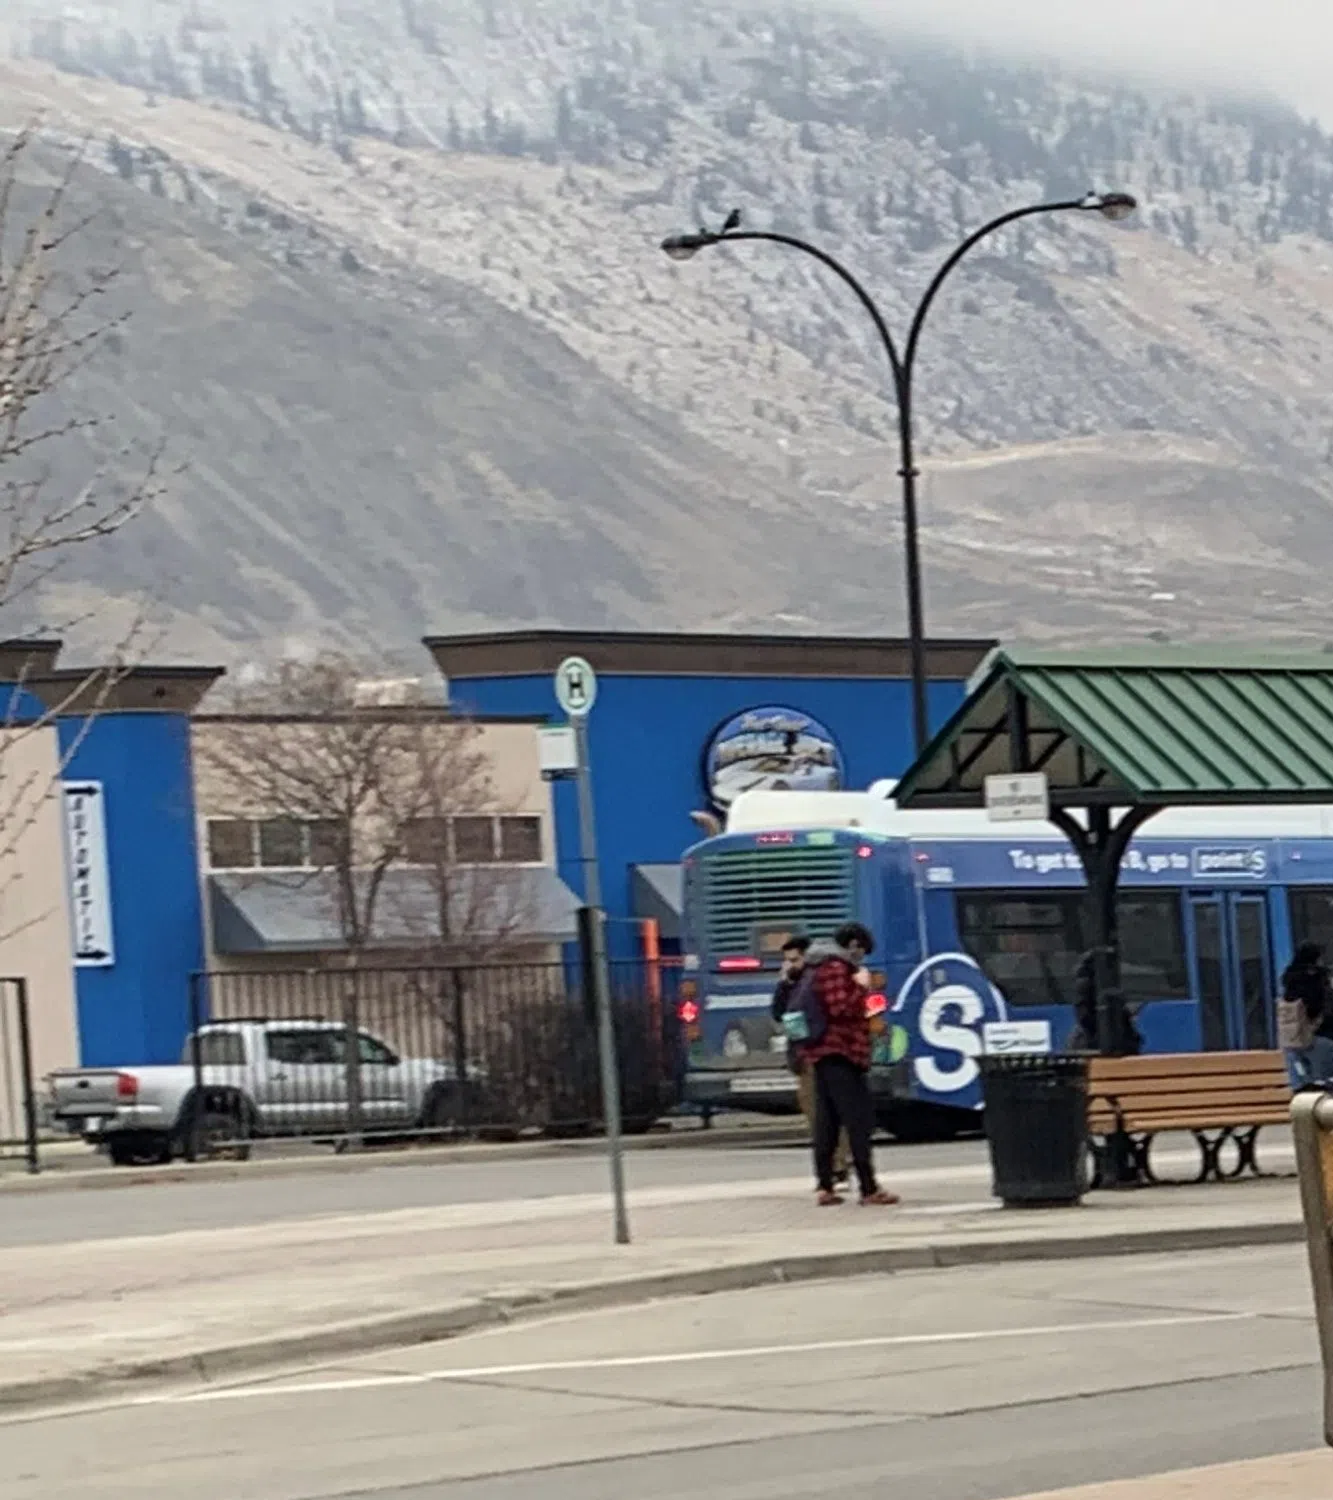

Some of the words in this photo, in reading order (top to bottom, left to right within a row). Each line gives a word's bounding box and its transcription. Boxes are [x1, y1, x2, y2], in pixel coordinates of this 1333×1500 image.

[1008, 849, 1033, 869] To
[1170, 853, 1189, 869] to
[913, 984, 985, 1093] S
